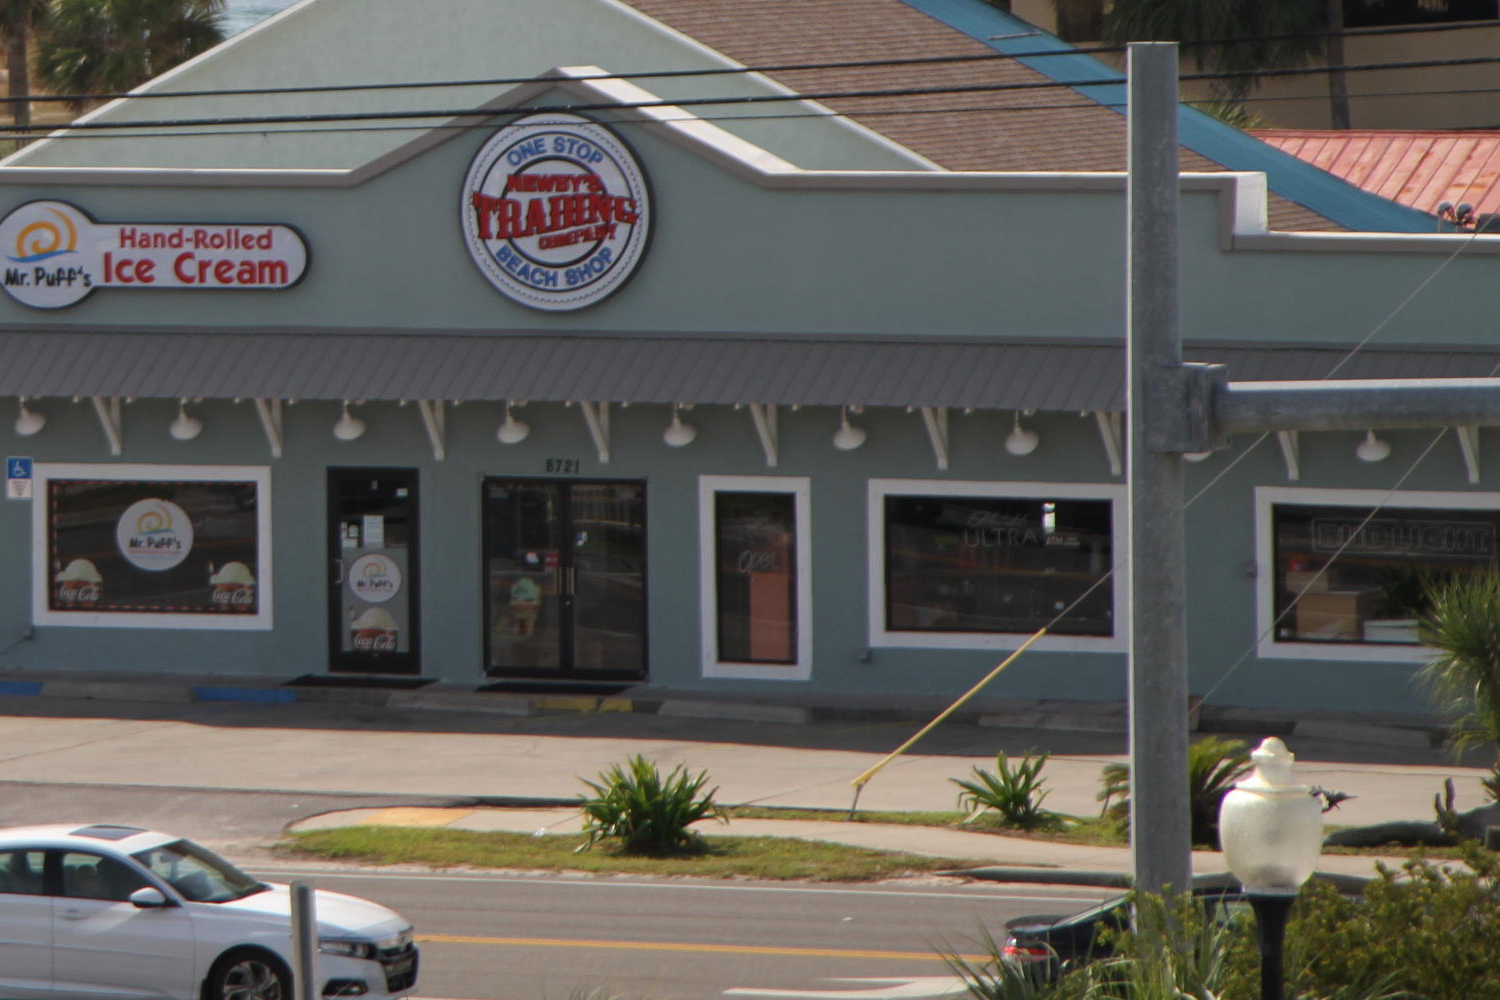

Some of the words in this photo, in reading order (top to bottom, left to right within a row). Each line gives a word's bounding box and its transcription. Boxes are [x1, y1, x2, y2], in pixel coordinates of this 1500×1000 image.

[506, 137, 548, 167] ONE
[553, 136, 604, 165] STOP
[507, 173, 604, 193] NEWBY'S
[472, 191, 641, 240] TRADING
[119, 228, 273, 250] Hand-Rolled
[5, 266, 31, 287] Mr.
[34, 266, 92, 288] Puff's
[103, 252, 156, 284] Ice
[173, 252, 289, 285] Cream
[495, 244, 559, 288] BEACH
[564, 246, 613, 287] SHOP
[546, 458, 581, 474] 8721
[963, 527, 1038, 547] ULTRA
